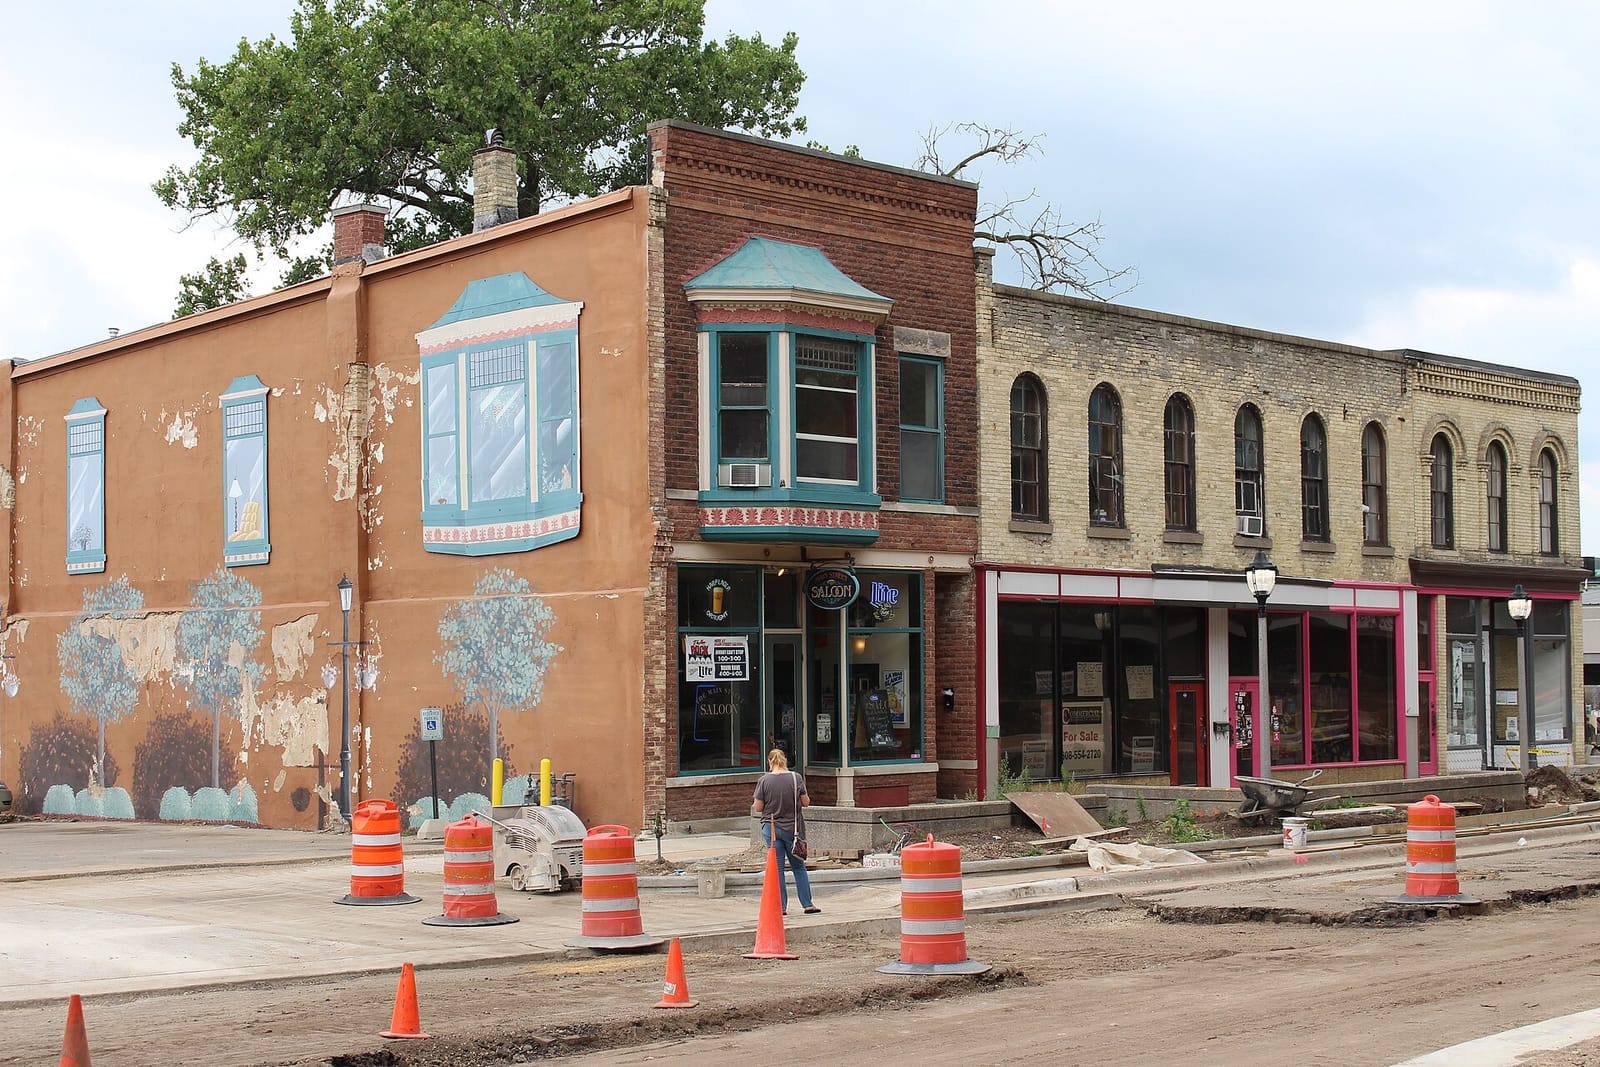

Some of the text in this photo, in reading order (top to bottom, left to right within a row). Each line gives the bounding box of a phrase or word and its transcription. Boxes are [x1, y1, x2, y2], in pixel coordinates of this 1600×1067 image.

[811, 585, 852, 598] SALOON
[870, 581, 899, 608] Lite
[699, 666, 712, 678] Lite
[700, 703, 738, 716] SALOON
[1064, 731, 1099, 741] For Sale
[1062, 749, 1101, 760] 08-554-2720
